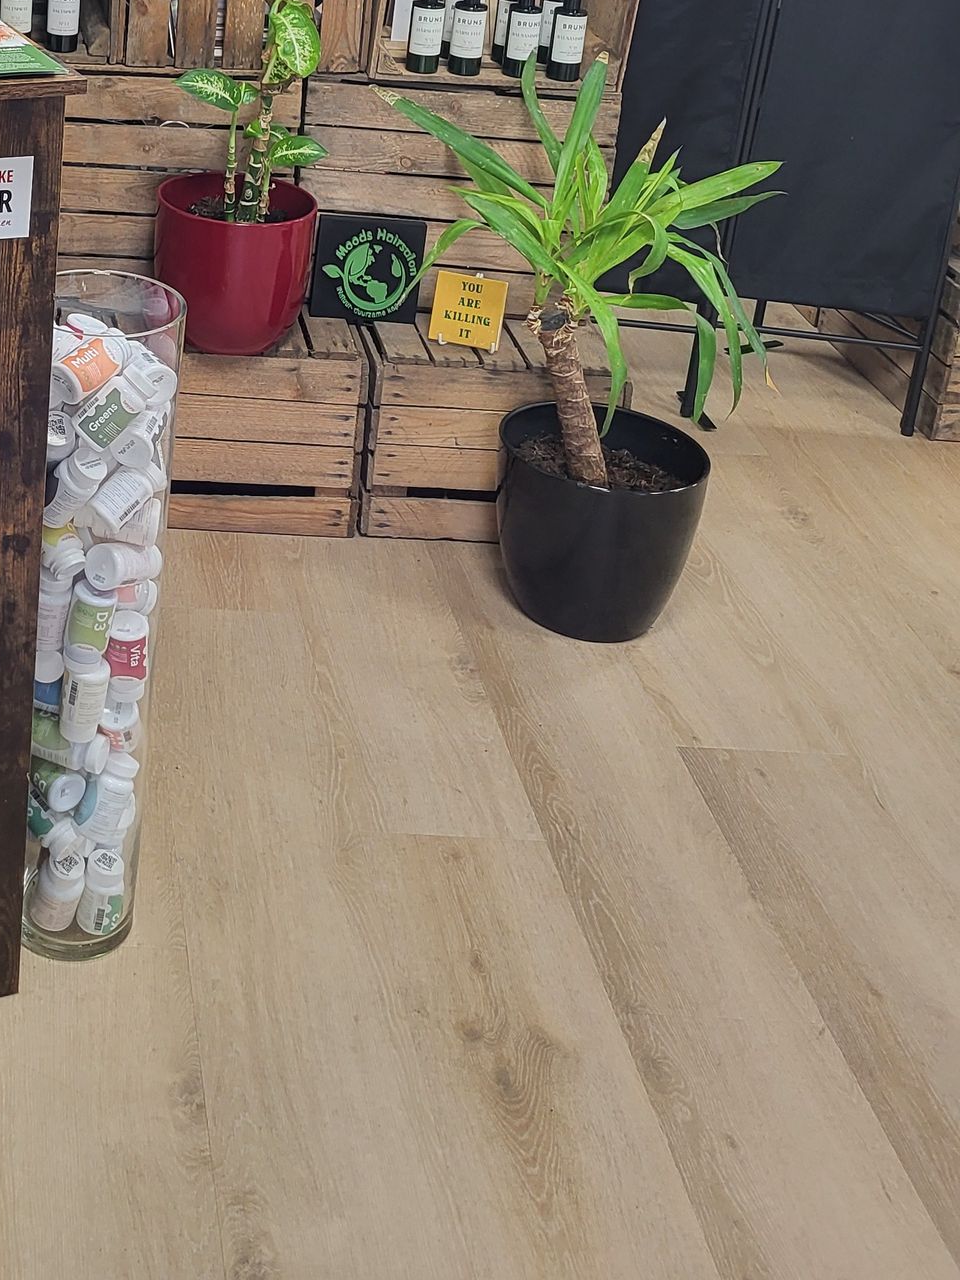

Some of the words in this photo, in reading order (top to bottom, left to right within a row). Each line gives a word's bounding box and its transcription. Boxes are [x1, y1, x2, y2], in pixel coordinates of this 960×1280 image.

[418, 15, 443, 23] BRUNS
[457, 17, 483, 26] BRUNS
[335, 228, 374, 261] Moods
[376, 227, 418, 277] Hairsalon
[461, 280, 483, 294] YOU
[457, 294, 481, 309] ARE
[443, 309, 491, 327] KILLING
[458, 328, 472, 339] IT
[70, 347, 100, 369] Multi
[87, 402, 119, 432] Greens
[94, 611, 109, 632] D3
[130, 644, 142, 667] Vita
